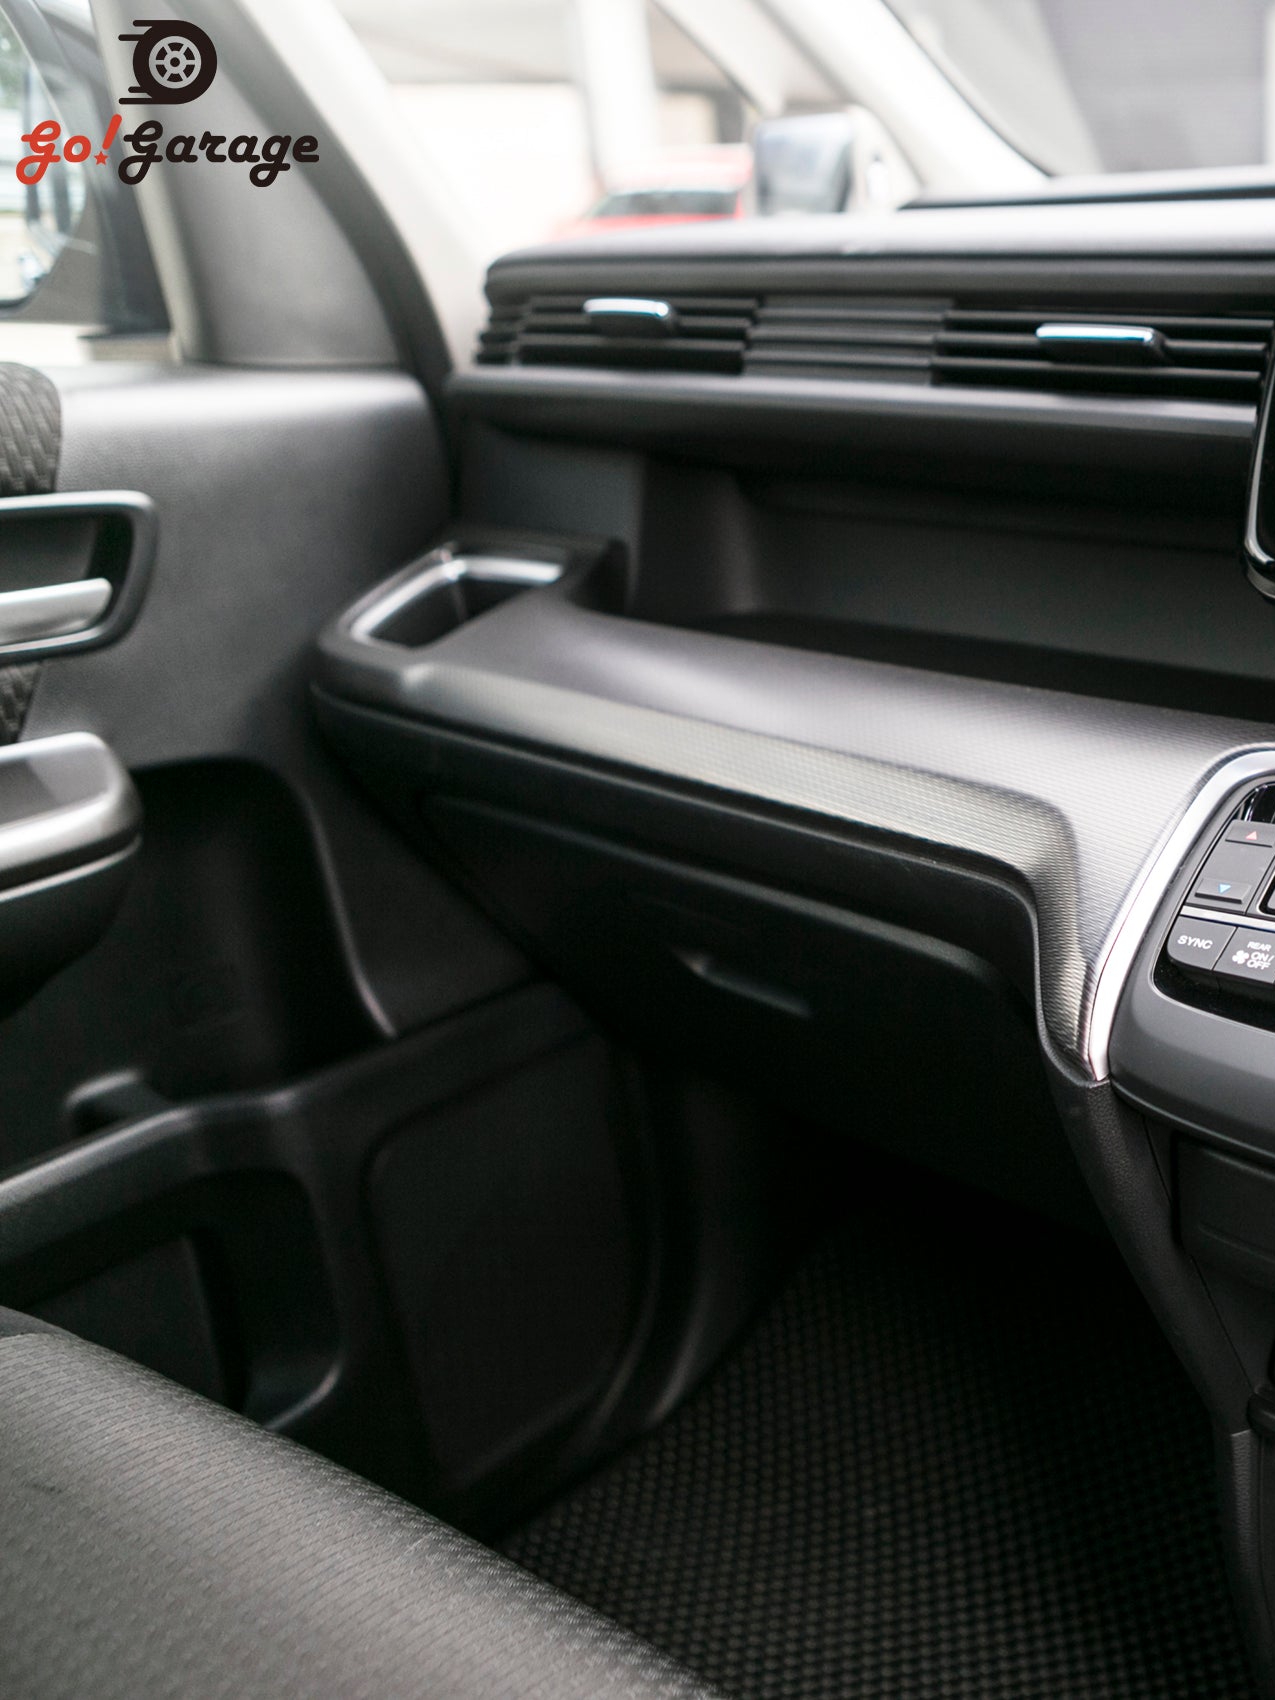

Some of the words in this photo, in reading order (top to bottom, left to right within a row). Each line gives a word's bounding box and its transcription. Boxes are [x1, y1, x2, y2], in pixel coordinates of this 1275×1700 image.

[1177, 934, 1214, 951] SYNC
[1246, 940, 1272, 952] REAR
[1246, 959, 1272, 970] OFF
